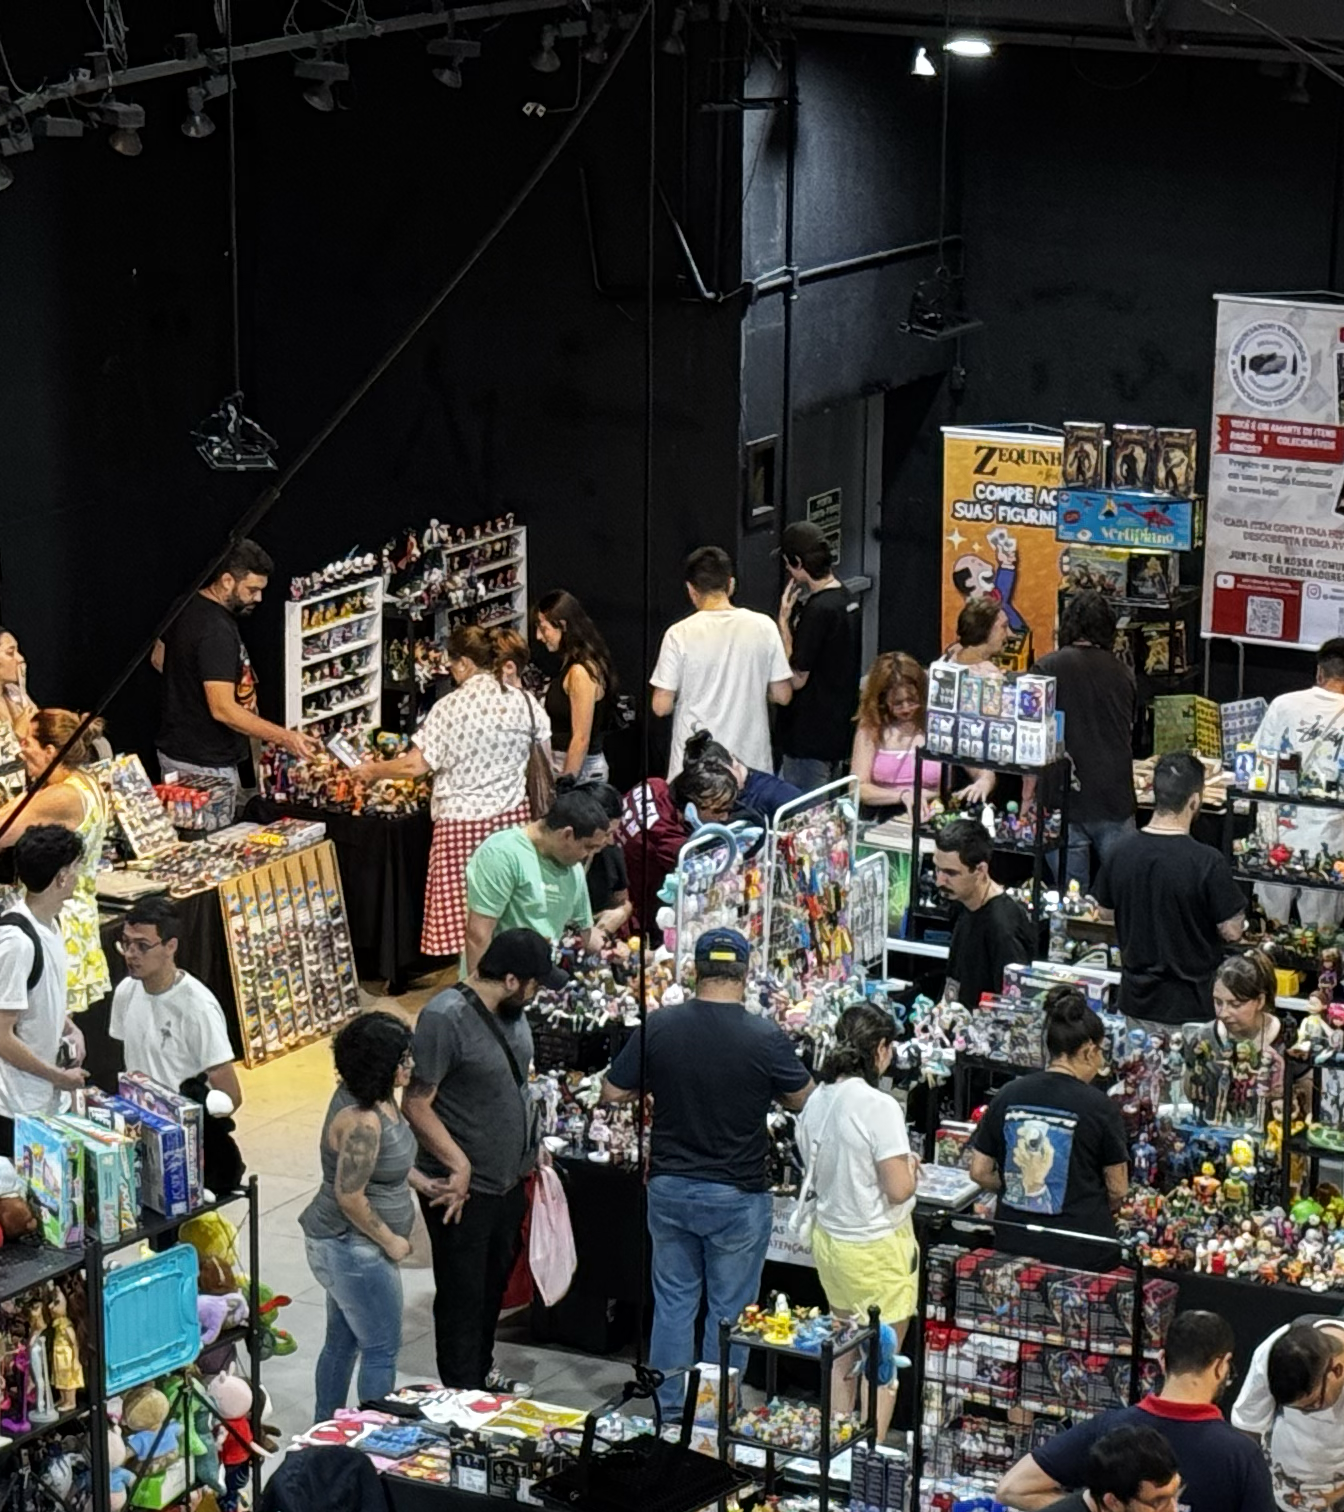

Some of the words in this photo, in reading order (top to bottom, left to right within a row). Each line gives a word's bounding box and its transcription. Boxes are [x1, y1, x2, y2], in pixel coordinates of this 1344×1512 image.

[973, 445, 1062, 476] ZEQUINH
[975, 483, 1034, 504] COMPRE
[954, 502, 993, 521] SUAS
[1224, 517, 1249, 528] CADA
[1228, 550, 1274, 565] JUNTE-SE
[1283, 555, 1314, 568] NOSSA
